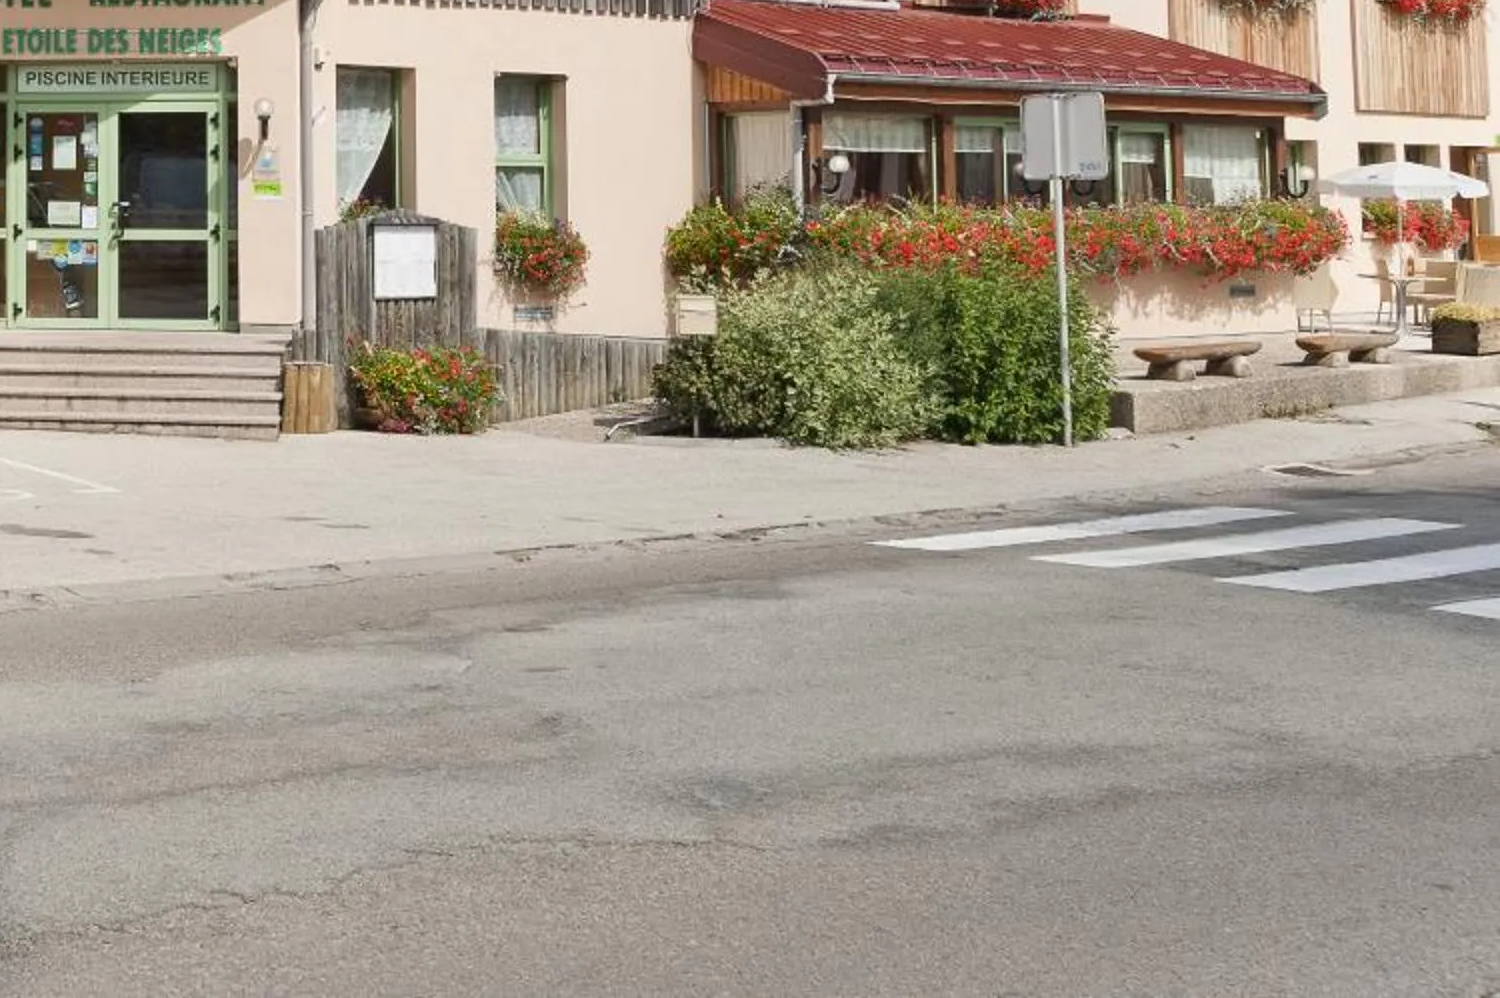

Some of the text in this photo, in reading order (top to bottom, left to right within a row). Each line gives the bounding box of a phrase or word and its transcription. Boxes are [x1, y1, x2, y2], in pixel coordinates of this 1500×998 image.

[3, 27, 223, 54] ETOILE DES NEIGES
[25, 71, 209, 85] PISCINE INTERIEURE
